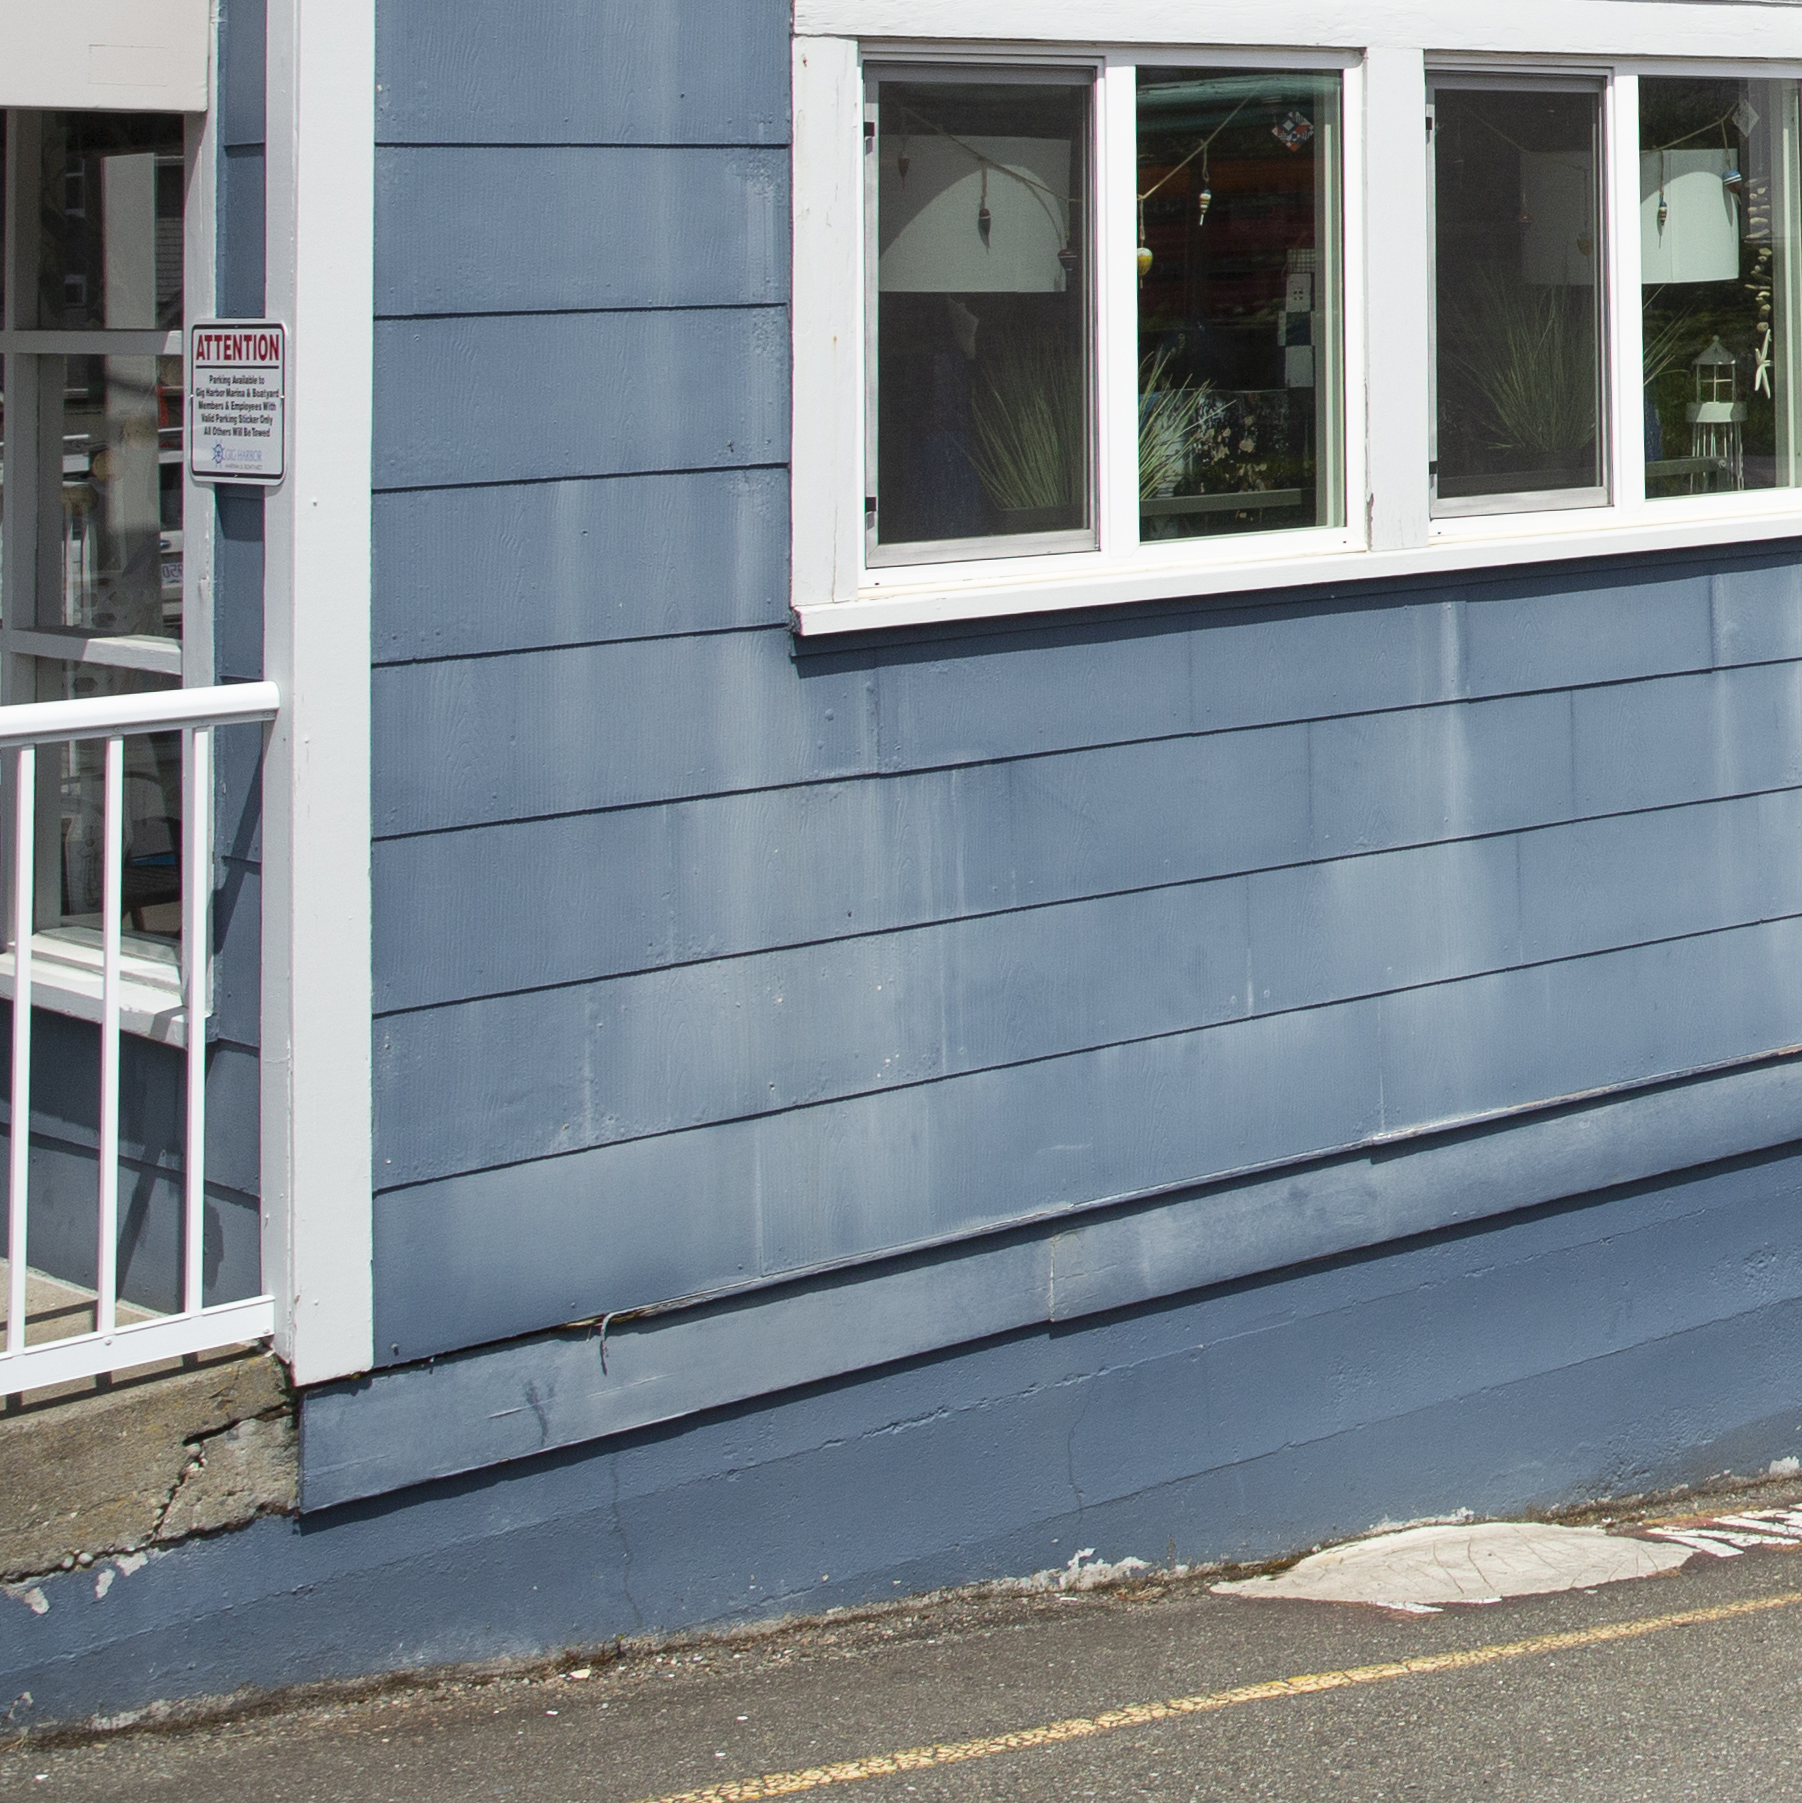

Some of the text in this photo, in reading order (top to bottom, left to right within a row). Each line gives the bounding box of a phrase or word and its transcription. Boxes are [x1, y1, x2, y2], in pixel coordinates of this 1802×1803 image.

[196, 334, 279, 361] ATTENTION
[209, 375, 265, 386] Parking Available to
[196, 387, 279, 399] Gig Harbor Marina & Boatyard
[198, 400, 277, 412] Members & Employees With
[201, 413, 273, 426] Valid Parking Sticker Only
[212, 426, 231, 436] Others
[232, 427, 243, 436] Will
[244, 427, 251, 437] Be
[251, 427, 271, 437] Towed
